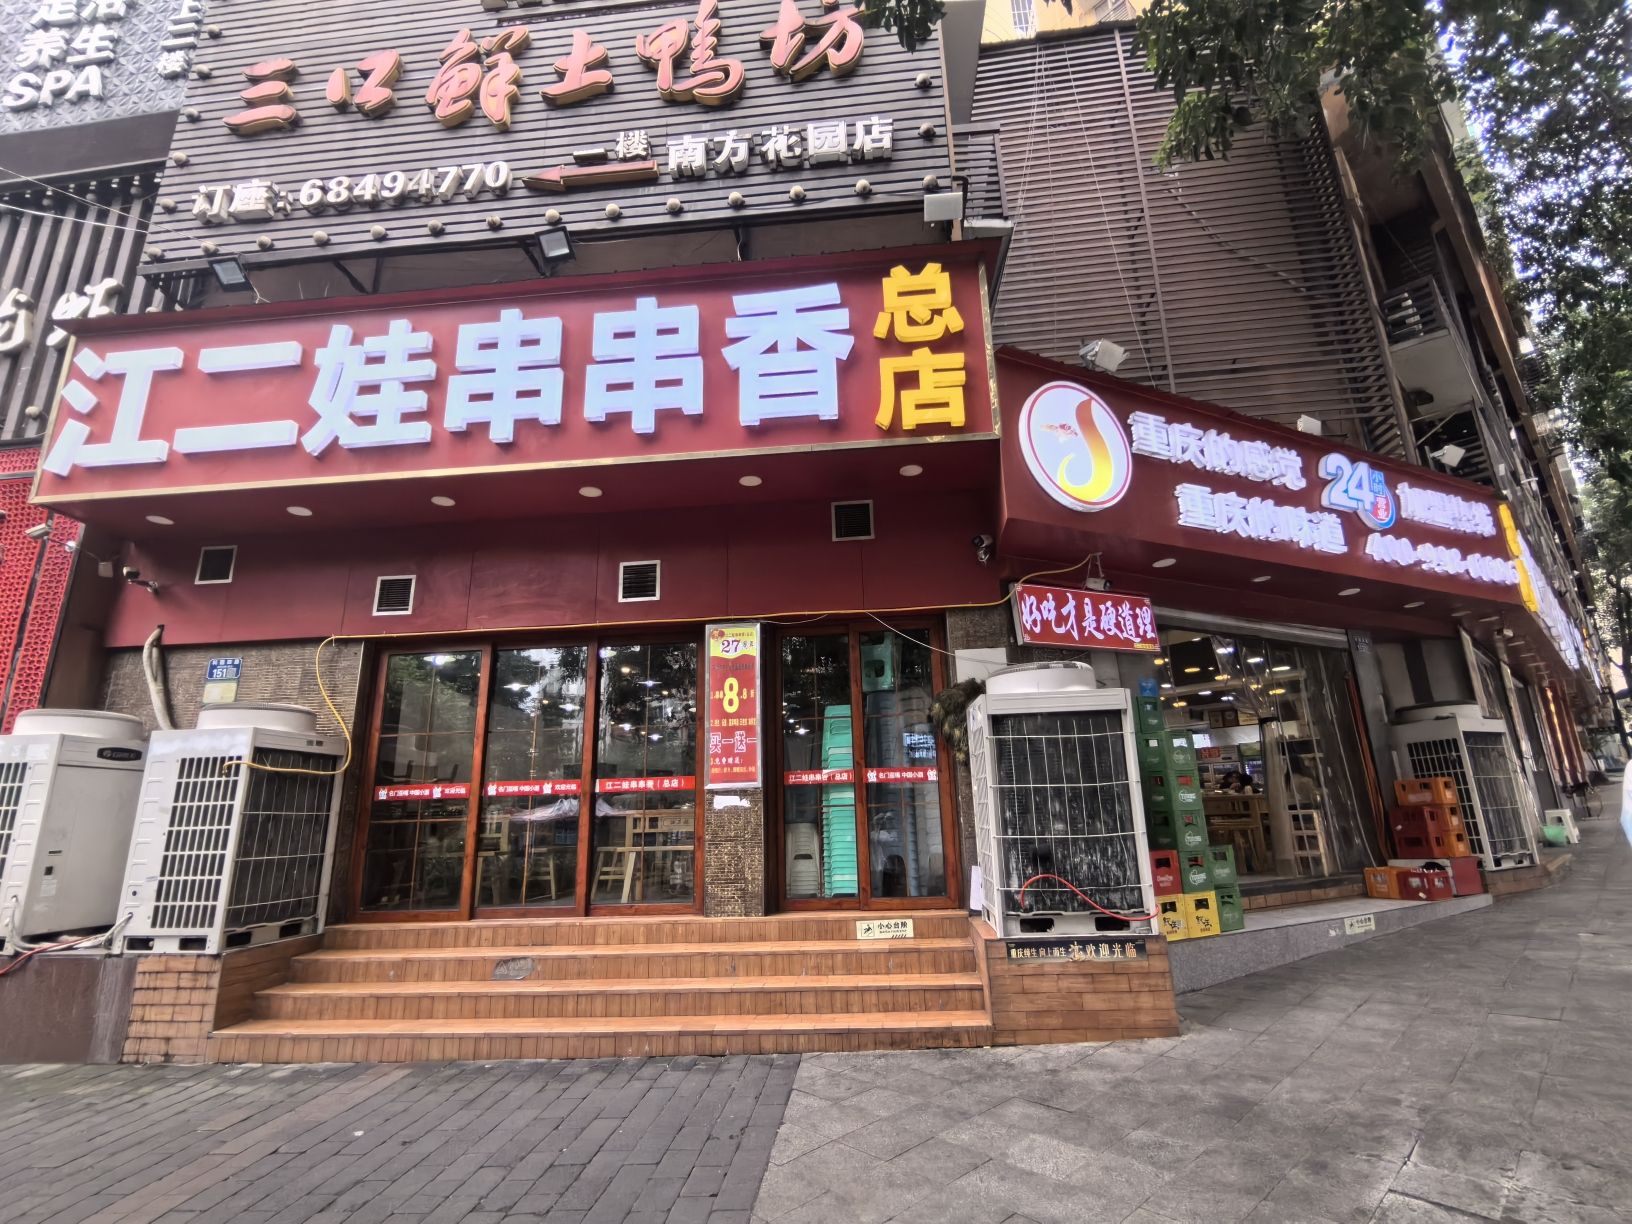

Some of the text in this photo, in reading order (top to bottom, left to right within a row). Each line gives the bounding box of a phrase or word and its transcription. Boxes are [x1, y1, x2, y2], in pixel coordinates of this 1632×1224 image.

[15, 24, 118, 70] 养生
[3, 66, 103, 112] SPA
[667, 116, 894, 181] 南方花园店
[873, 261, 966, 431] 总店
[43, 282, 855, 477] 江二娃串串香
[710, 731, 757, 754] 买一送一
[1085, 942, 1137, 958] 欢迎光临
